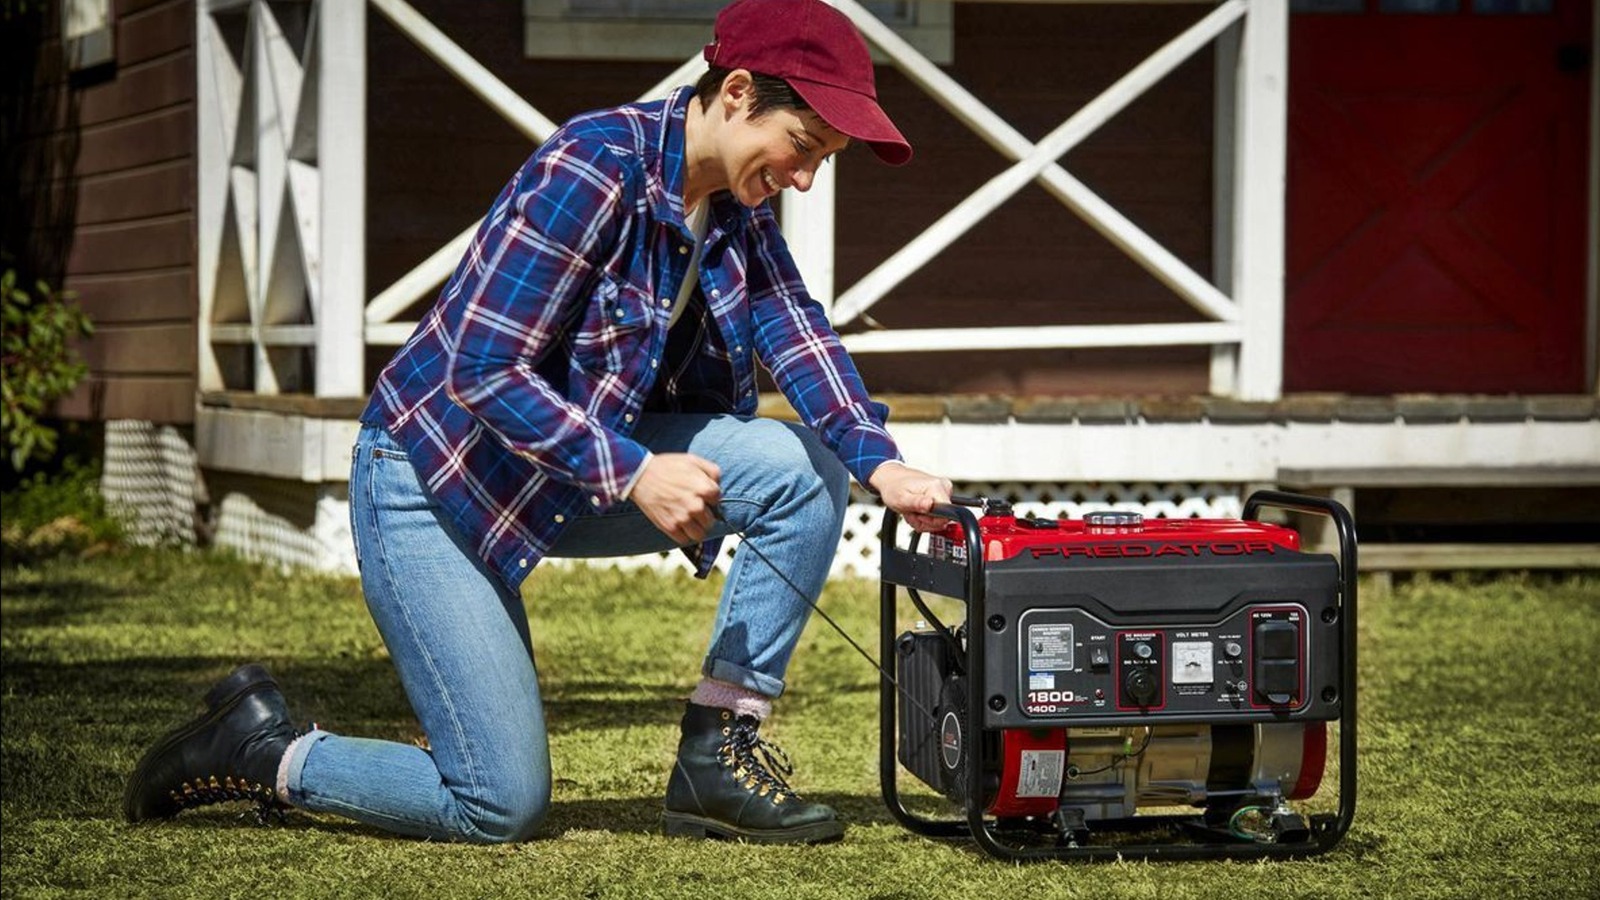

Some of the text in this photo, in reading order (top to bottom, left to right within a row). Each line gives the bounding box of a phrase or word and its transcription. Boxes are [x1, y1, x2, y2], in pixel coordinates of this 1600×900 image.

[1030, 541, 1276, 559] PREDATOR
[1027, 691, 1074, 703] 1800
[1027, 705, 1057, 713] 1400
